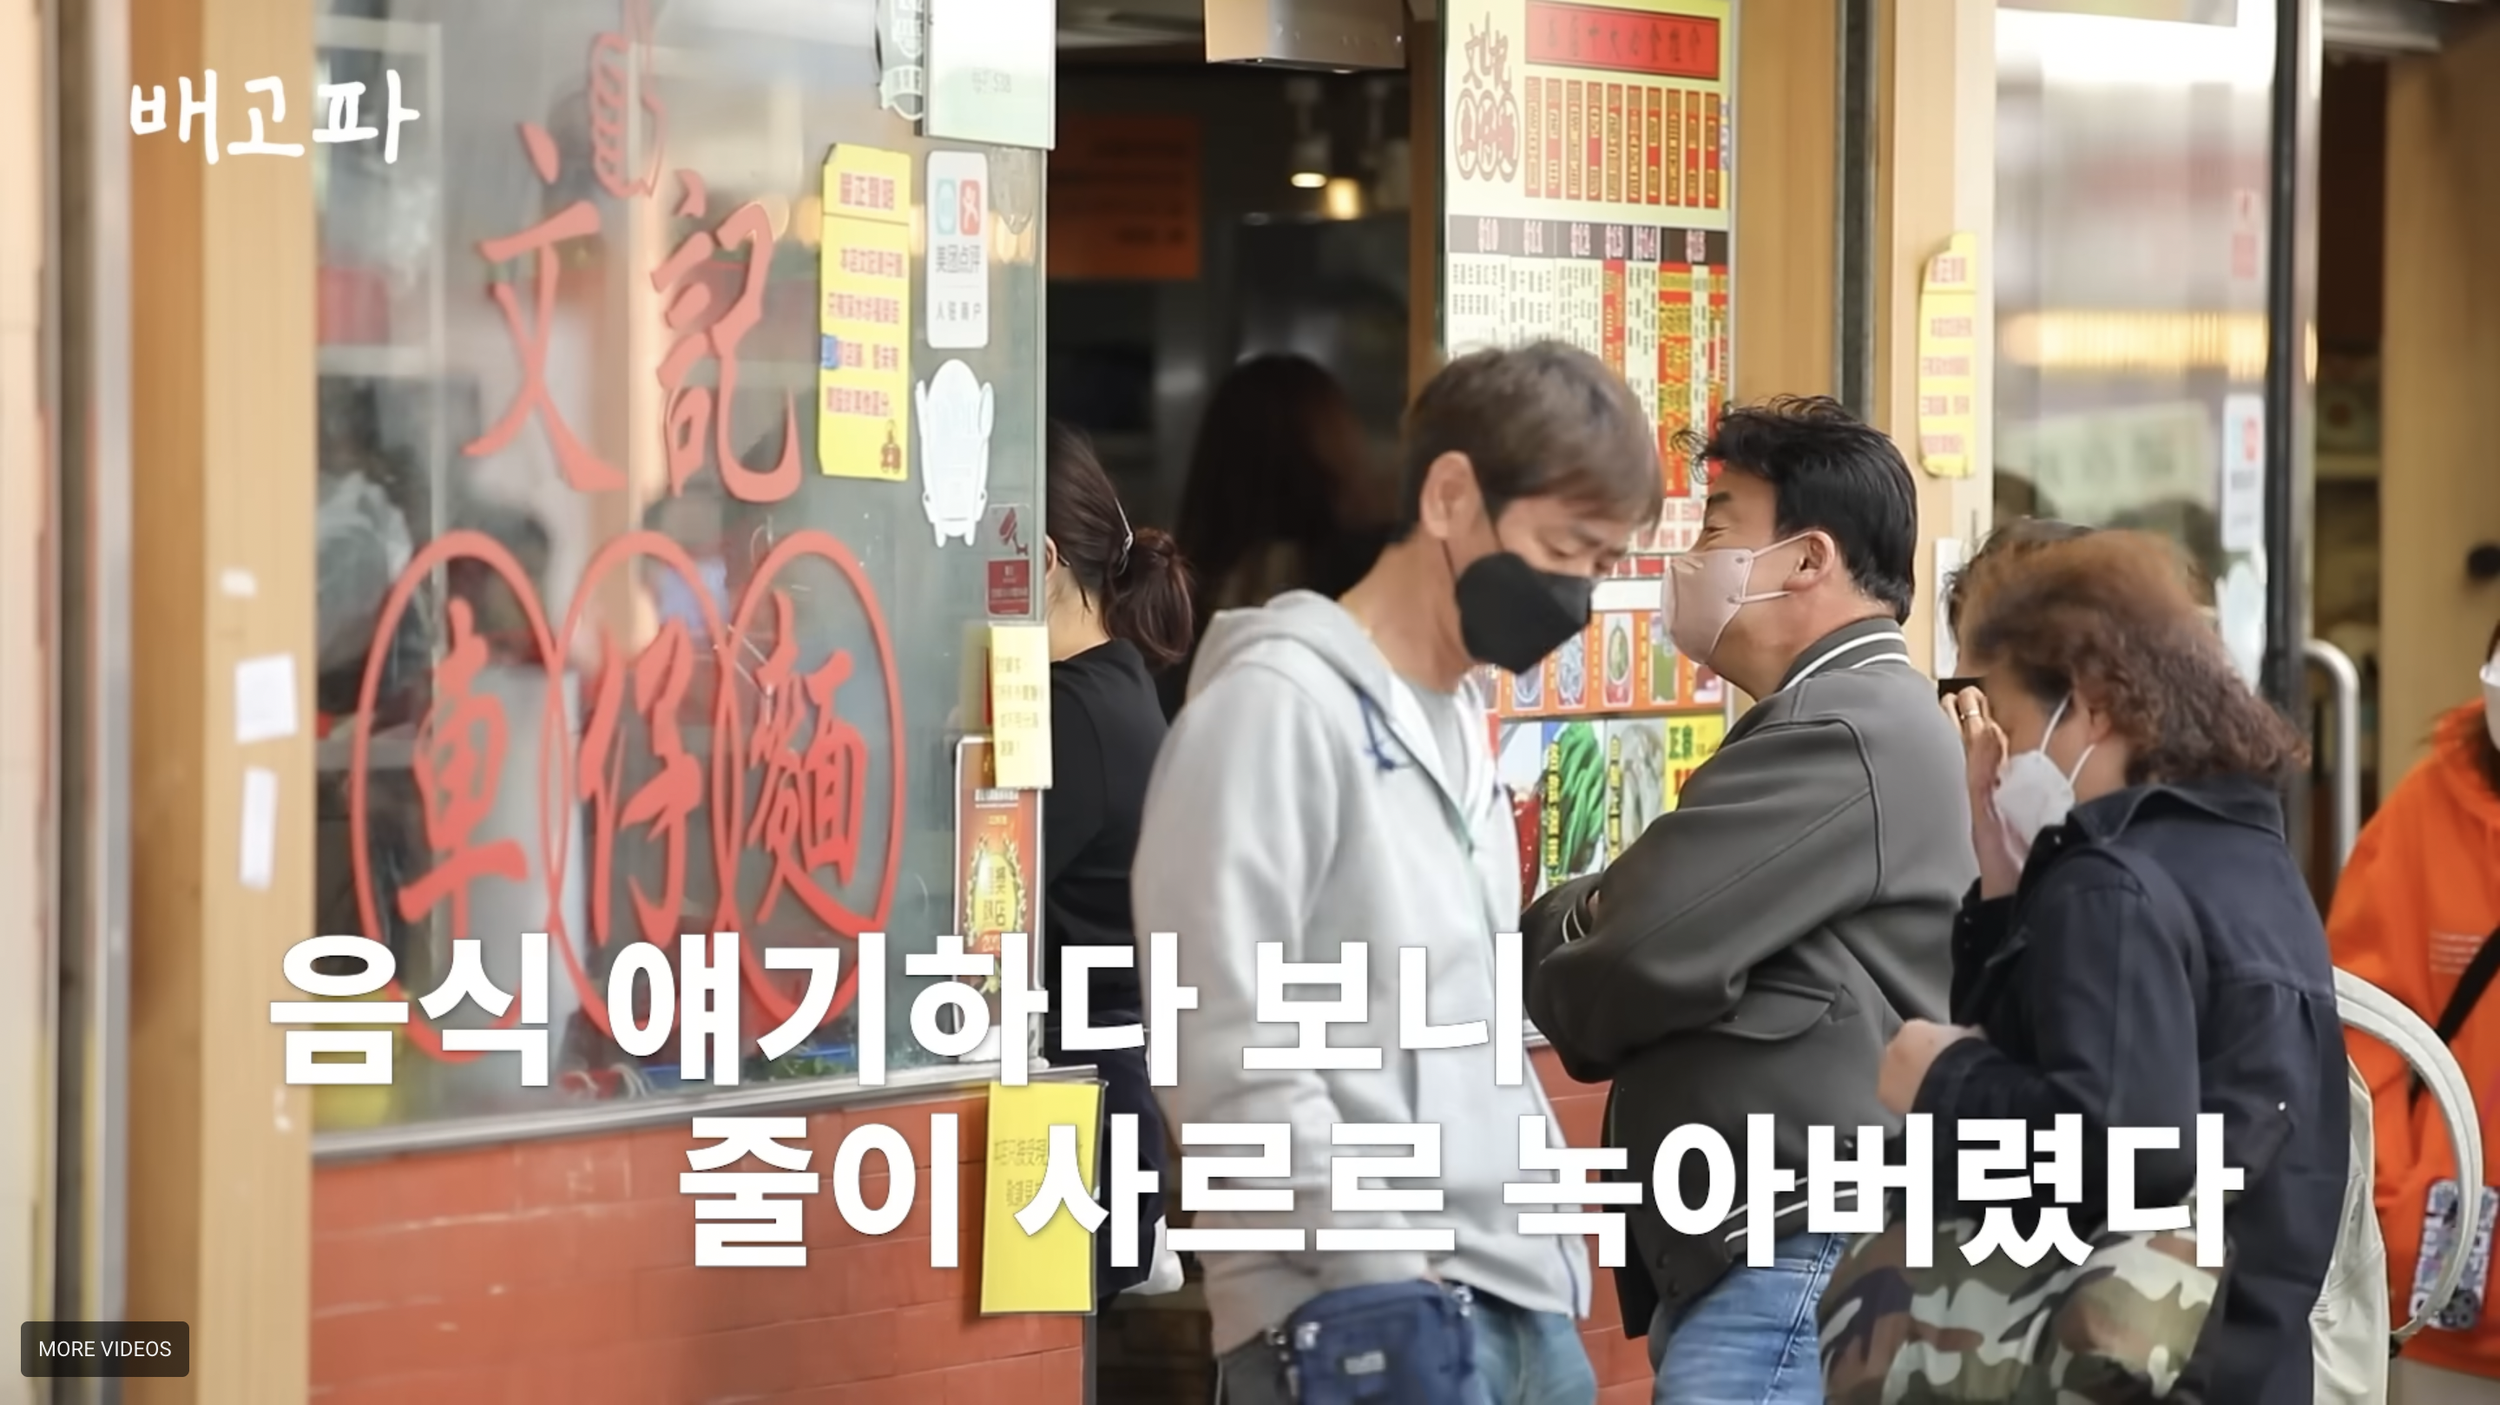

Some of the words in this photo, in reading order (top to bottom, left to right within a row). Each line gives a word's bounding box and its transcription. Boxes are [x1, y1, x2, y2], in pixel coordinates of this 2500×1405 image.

[460, 122, 801, 502] 文記
[396, 588, 877, 948] 車仔麵
